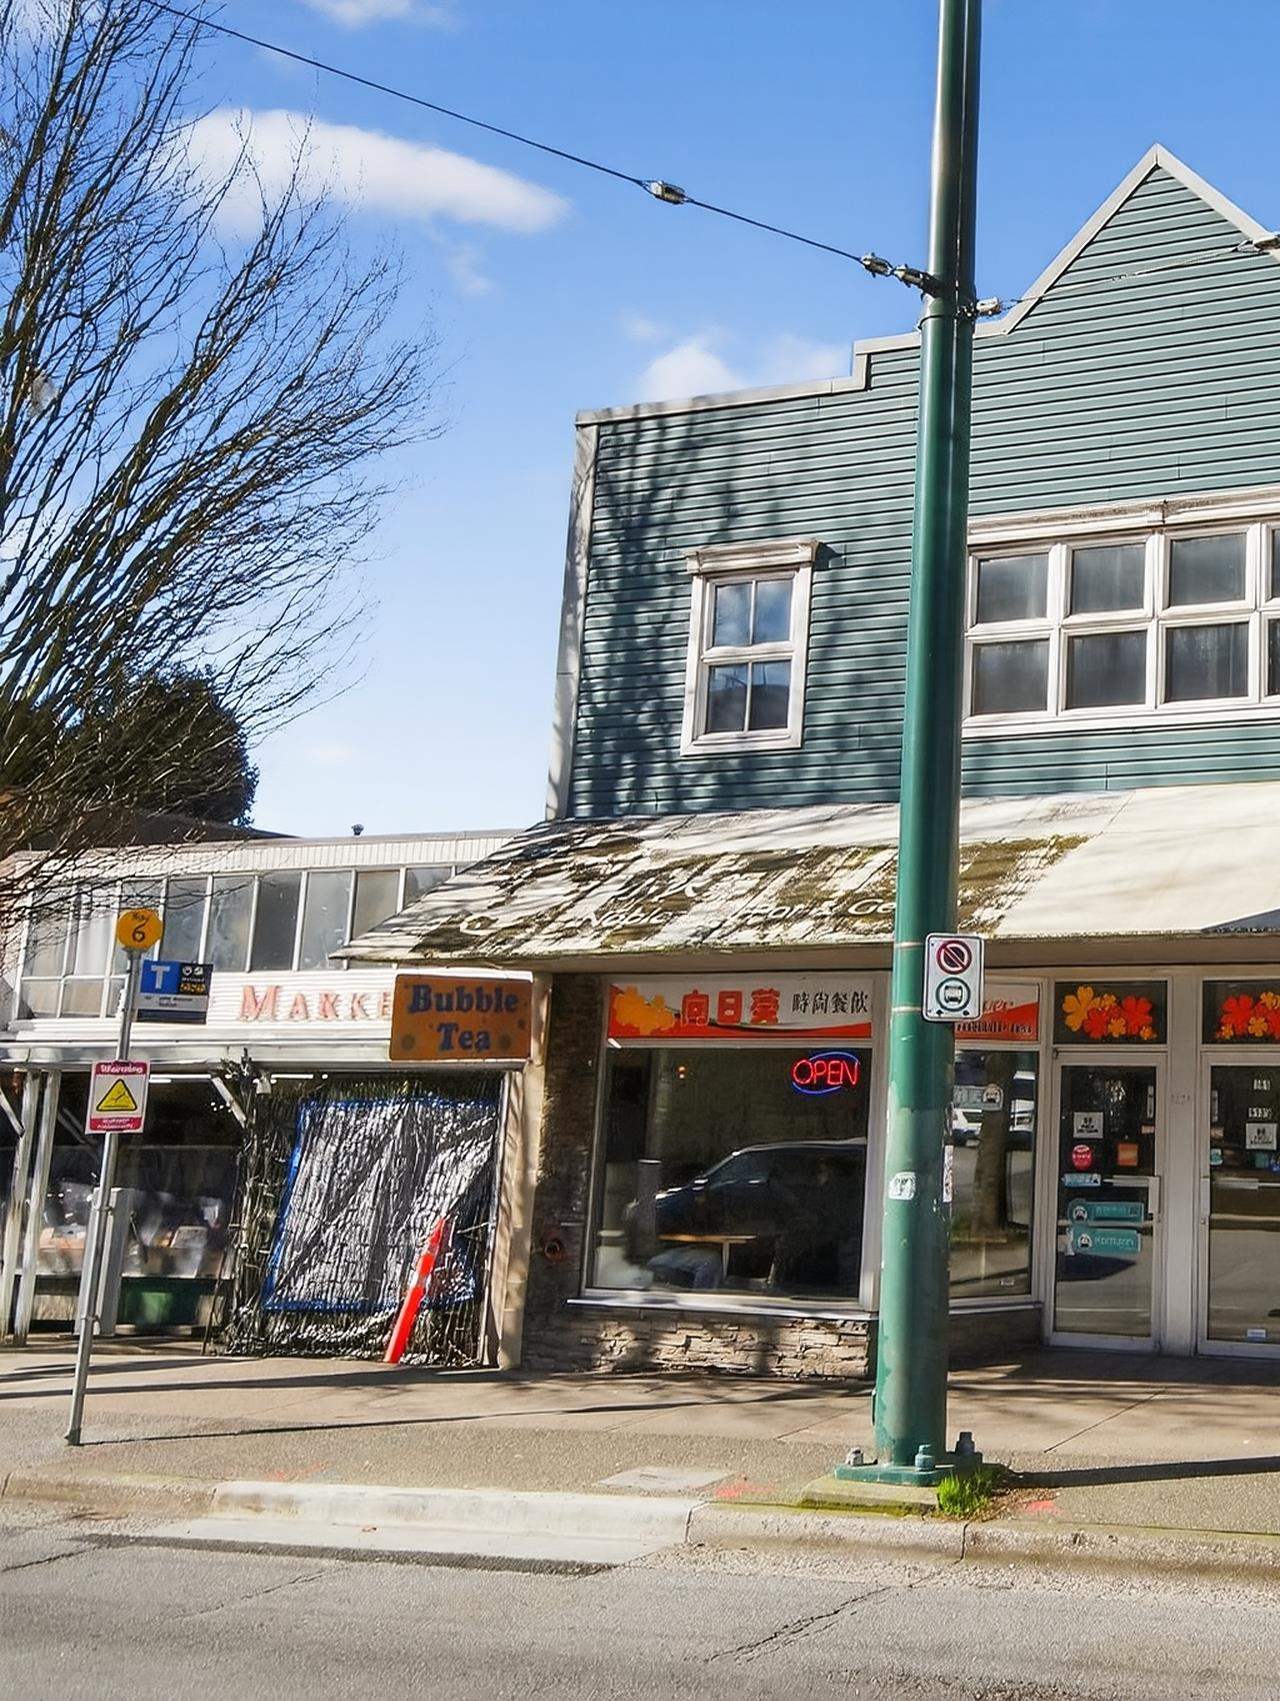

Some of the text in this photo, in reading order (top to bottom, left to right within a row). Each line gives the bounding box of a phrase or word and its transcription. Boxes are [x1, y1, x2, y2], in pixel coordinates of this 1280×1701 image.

[407, 984, 520, 1014] Bubble
[437, 1022, 492, 1052] Tea
[791, 1058, 860, 1087] OPEN
